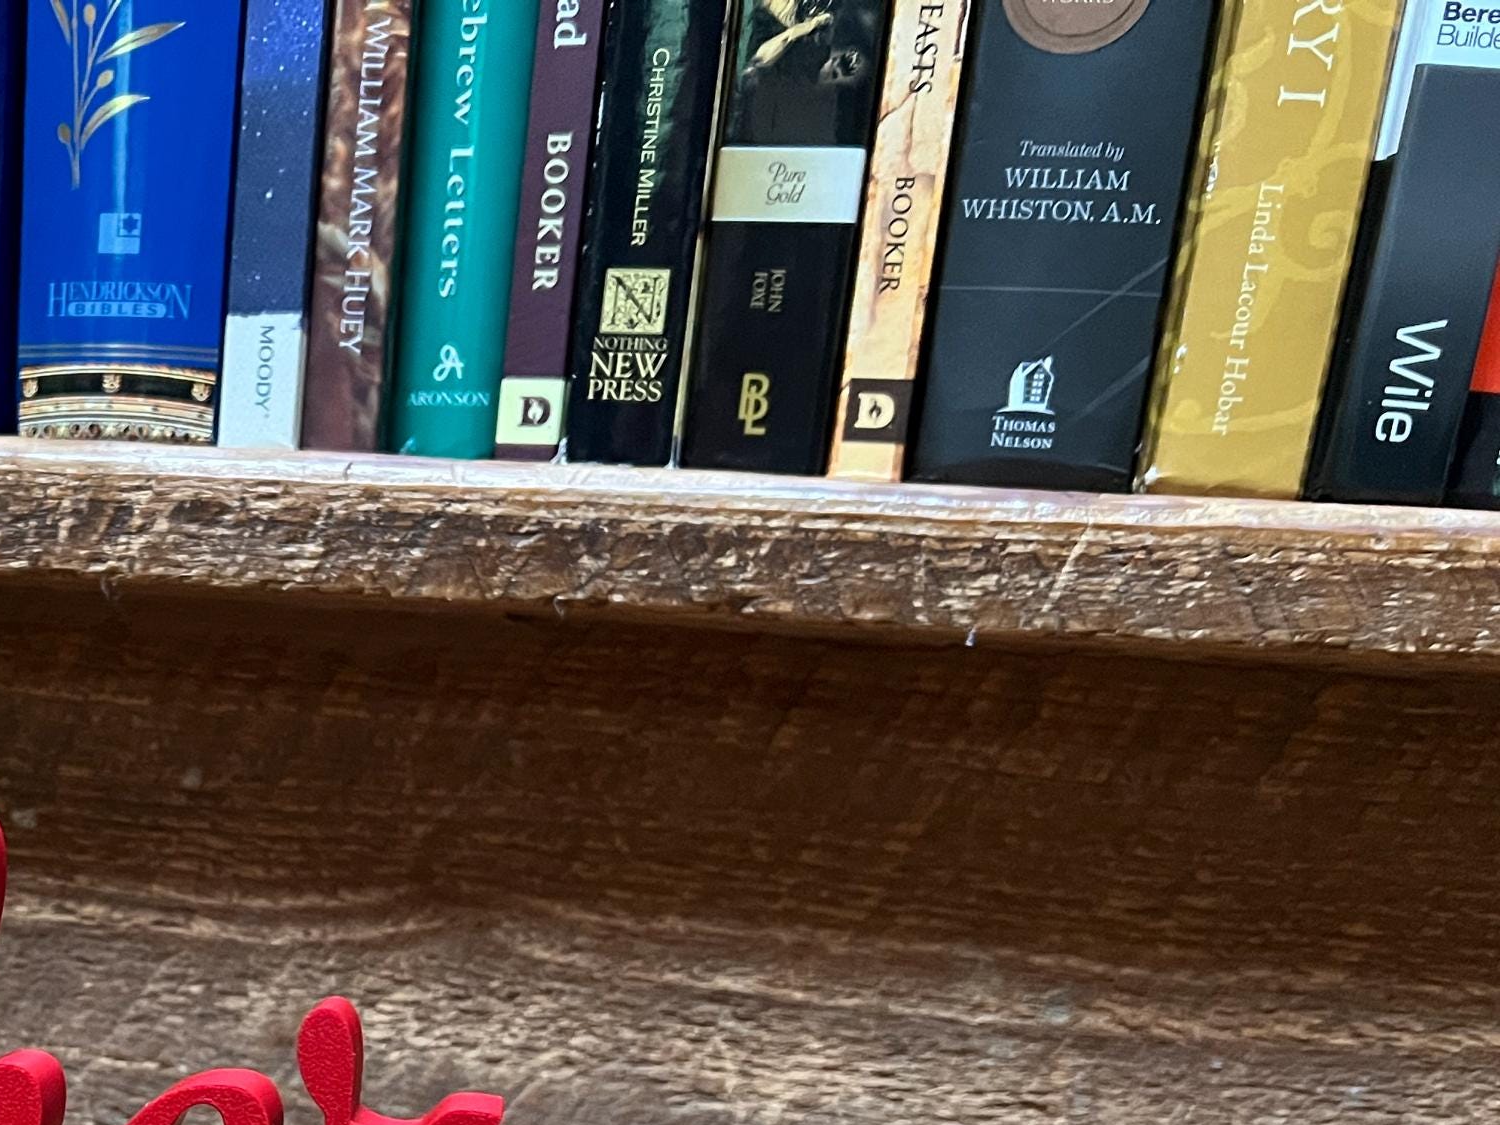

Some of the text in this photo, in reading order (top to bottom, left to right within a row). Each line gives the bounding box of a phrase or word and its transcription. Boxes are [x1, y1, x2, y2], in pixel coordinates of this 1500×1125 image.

[909, 3, 944, 95] EASTS
[1277, 84, 1327, 110] I
[630, 48, 670, 248] CHRISTINE MILLER
[1019, 140, 1125, 162] Translated by
[768, 161, 807, 183] Pure
[1005, 167, 1132, 191] WILLIAM
[338, 16, 392, 357] WILLIAM MARK HUEY
[765, 184, 806, 206] Gold
[438, 145, 476, 299] Letters
[531, 131, 573, 291] BOOKER
[1100, 201, 1162, 225] A.M.
[878, 175, 916, 295] BOOKER
[47, 281, 194, 320] HENDRICKSON
[74, 303, 159, 316] BIBLES
[1211, 182, 1285, 436] Linda Lacour Hobar
[593, 336, 669, 351] NOTHING
[254, 325, 276, 408] MOODY
[589, 351, 669, 378] NEW
[587, 379, 663, 402] PRESS
[1375, 319, 1449, 443] Wile
[408, 391, 490, 408] ARONSON
